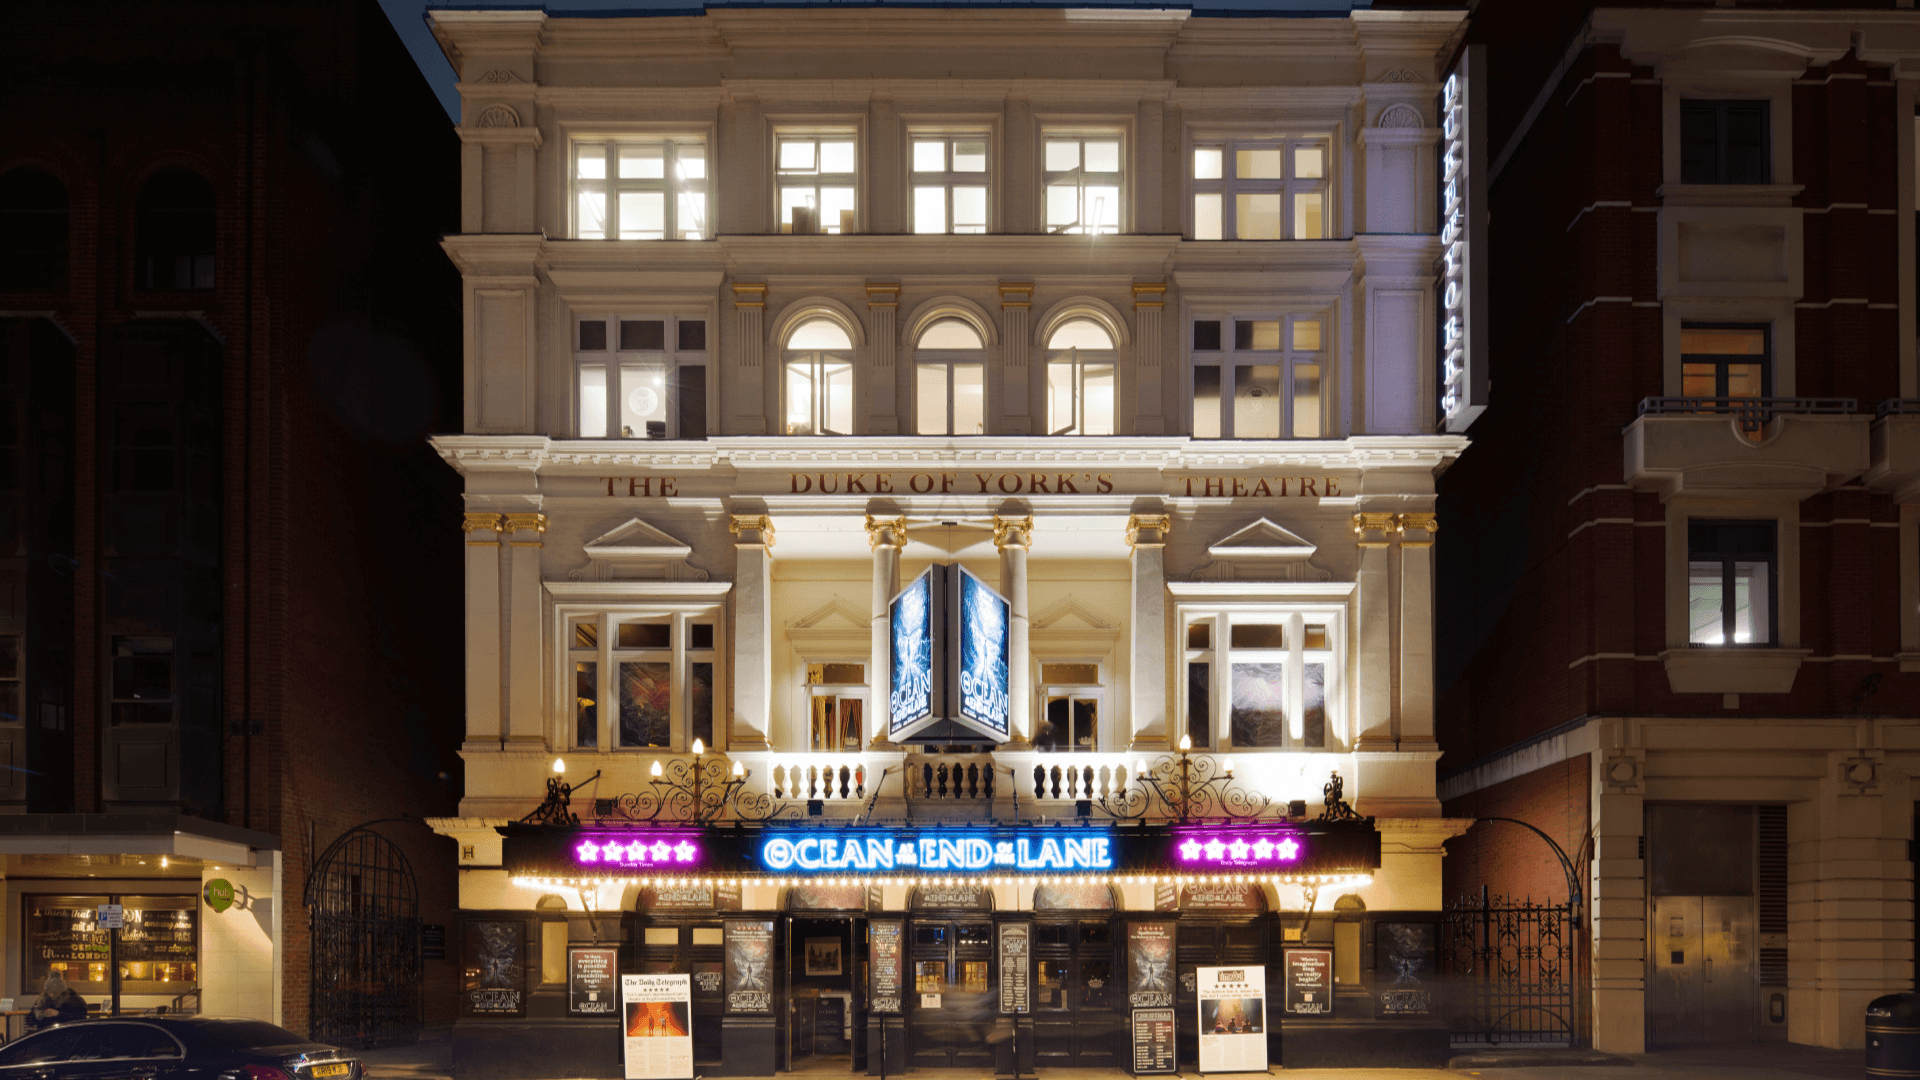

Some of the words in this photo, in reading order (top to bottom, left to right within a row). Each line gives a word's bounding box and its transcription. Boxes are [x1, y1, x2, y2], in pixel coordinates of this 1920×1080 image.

[600, 476, 679, 497] THE
[788, 473, 894, 494] DUKE
[909, 473, 958, 494] OF
[972, 473, 1114, 494] YORK'S
[1178, 477, 1342, 498] THEATRE
[961, 671, 1008, 716] OCEAN
[764, 838, 894, 869] OCEAN
[919, 838, 993, 868] END
[1017, 838, 1111, 868] LANE
[214, 886, 230, 897] hub
[639, 979, 655, 987] Daily
[656, 978, 687, 987] Telegraph
[471, 991, 520, 1003] OCEAN
[728, 993, 770, 1003] OCEAN
[1130, 993, 1172, 1004] OCEAN
[1381, 992, 1430, 1004] OCEAN
